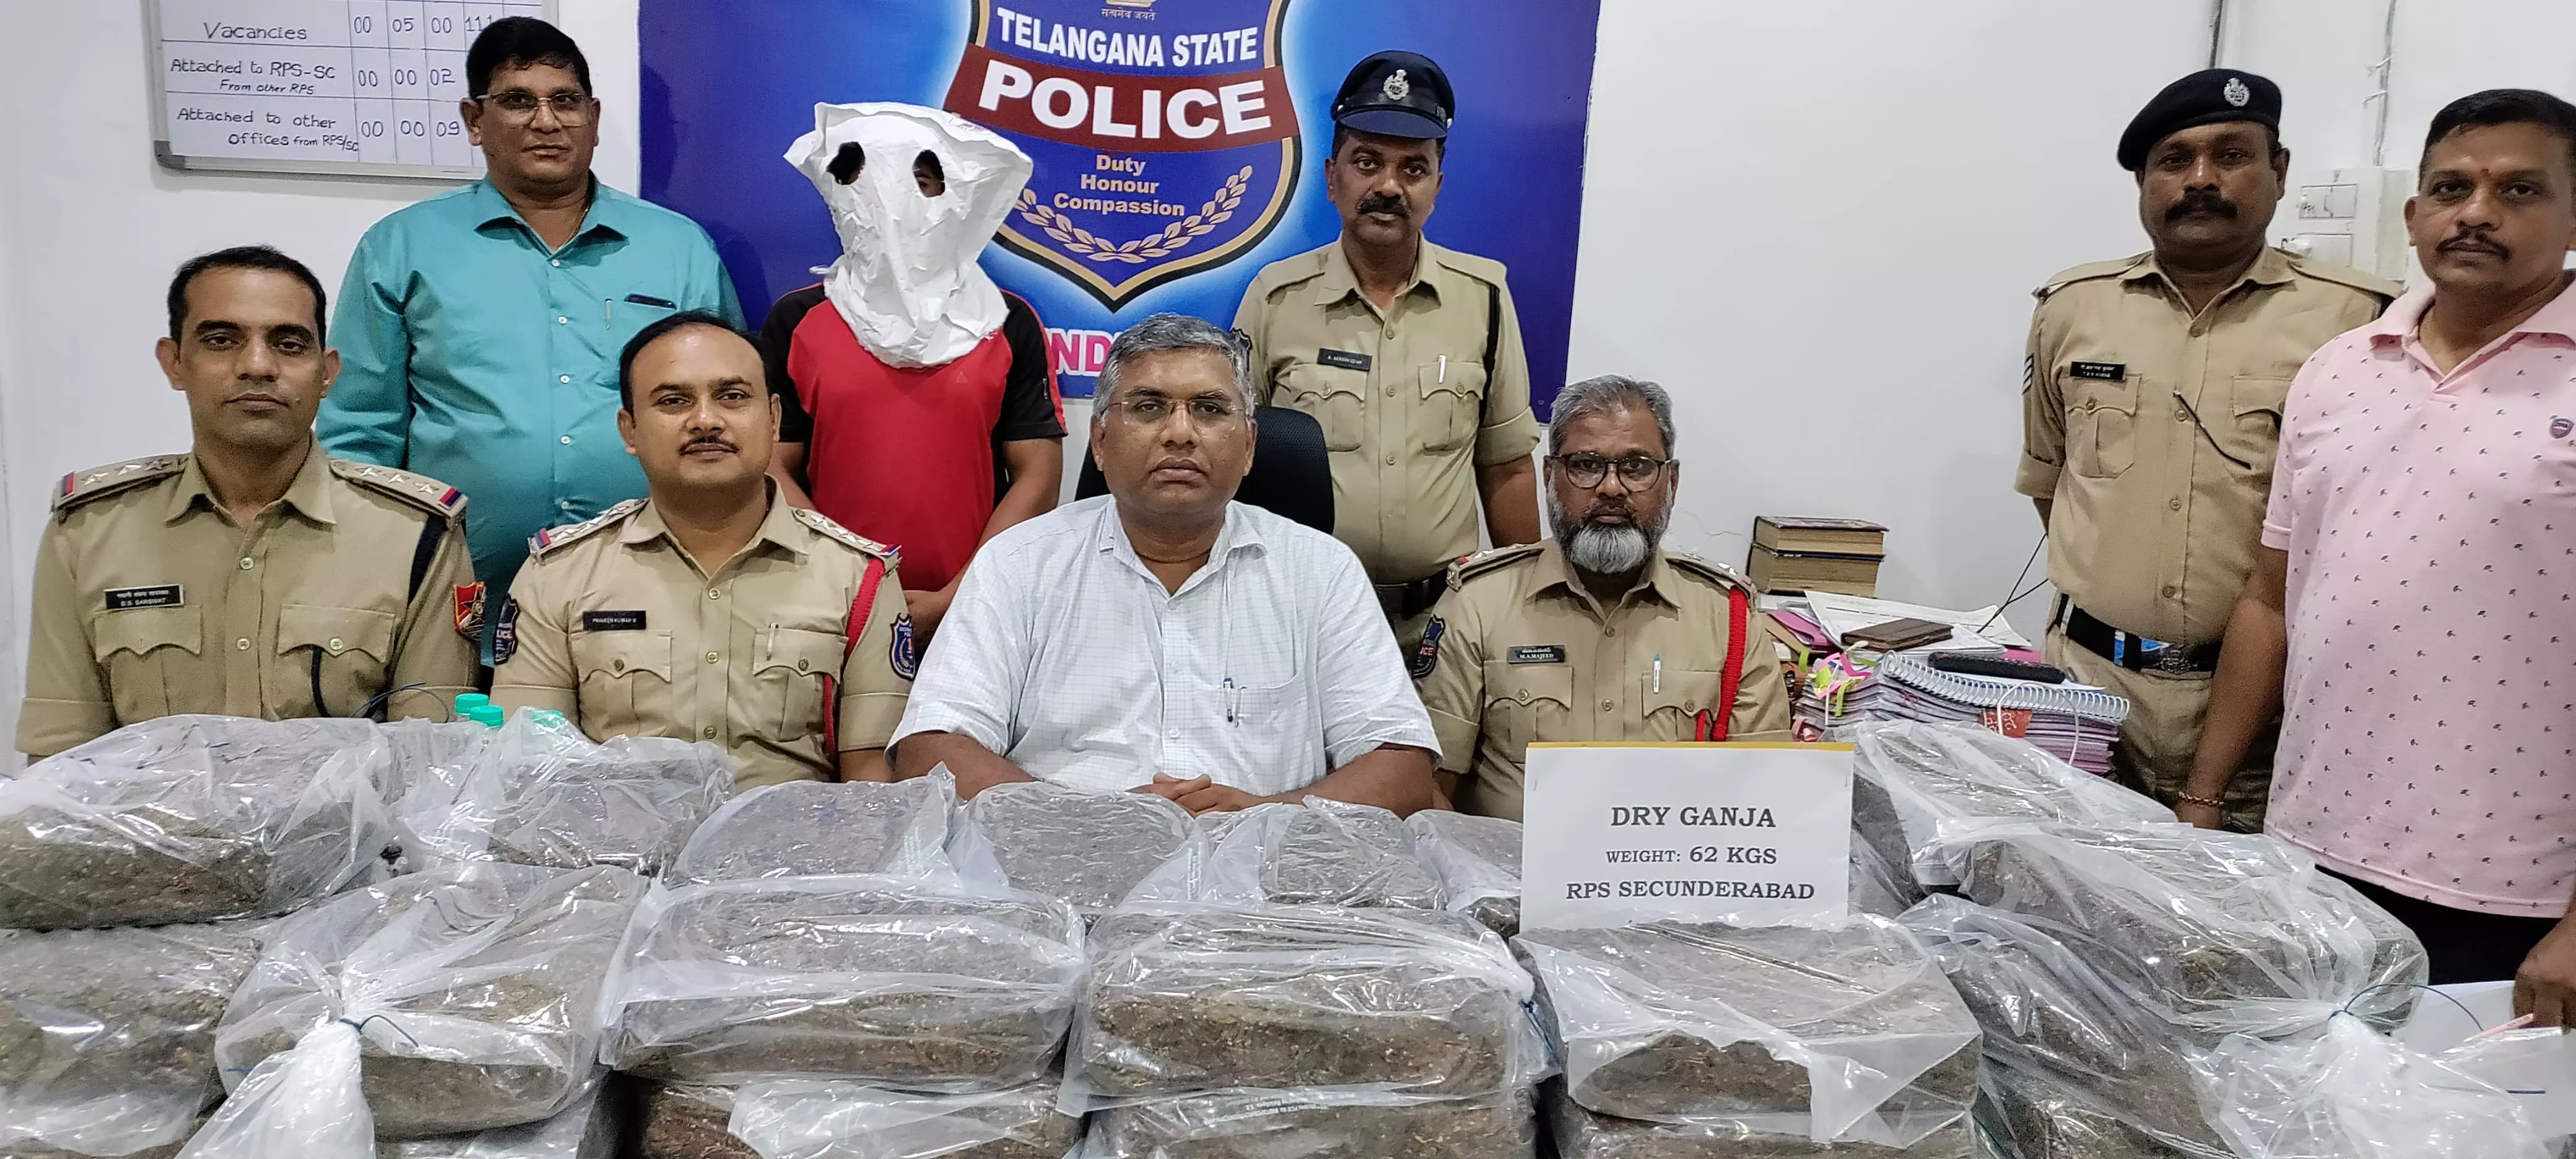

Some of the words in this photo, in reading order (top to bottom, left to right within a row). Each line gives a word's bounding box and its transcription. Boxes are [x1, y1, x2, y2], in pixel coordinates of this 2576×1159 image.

[203, 22, 308, 40] Vacancies
[354, 16, 372, 34] 00
[392, 17, 415, 33] 05
[431, 17, 452, 33] 00
[996, 7, 1164, 67] TELANGANA
[1172, 27, 1258, 67] STATE
[170, 58, 242, 74] Attached
[250, 60, 263, 74] to
[270, 61, 336, 79] RPS-SC
[358, 69, 378, 87] 00
[394, 69, 417, 85] 00
[430, 68, 456, 85] 02
[219, 79, 251, 92] From
[256, 82, 287, 94] other
[289, 83, 315, 95] RPS
[978, 59, 1272, 139] POLICE
[176, 107, 254, 123] Attached
[266, 112, 281, 125] to
[292, 114, 336, 129] other
[361, 121, 384, 138] 00
[400, 120, 425, 137] 00
[436, 120, 460, 138] 09
[292, 136, 318, 147] from
[1096, 154, 1146, 177] Duty
[1081, 173, 1160, 195] Honour
[1054, 193, 1185, 216] Compassion
[1611, 806, 1671, 826] DRY
[1679, 806, 1777, 828] GANJA
[1605, 849, 1681, 863] WEIGHT:
[1689, 846, 1718, 862] 62
[1726, 846, 1777, 865] KGS
[1565, 882, 1611, 899] RPS
[1618, 880, 1815, 899] SECUNDERABAD
